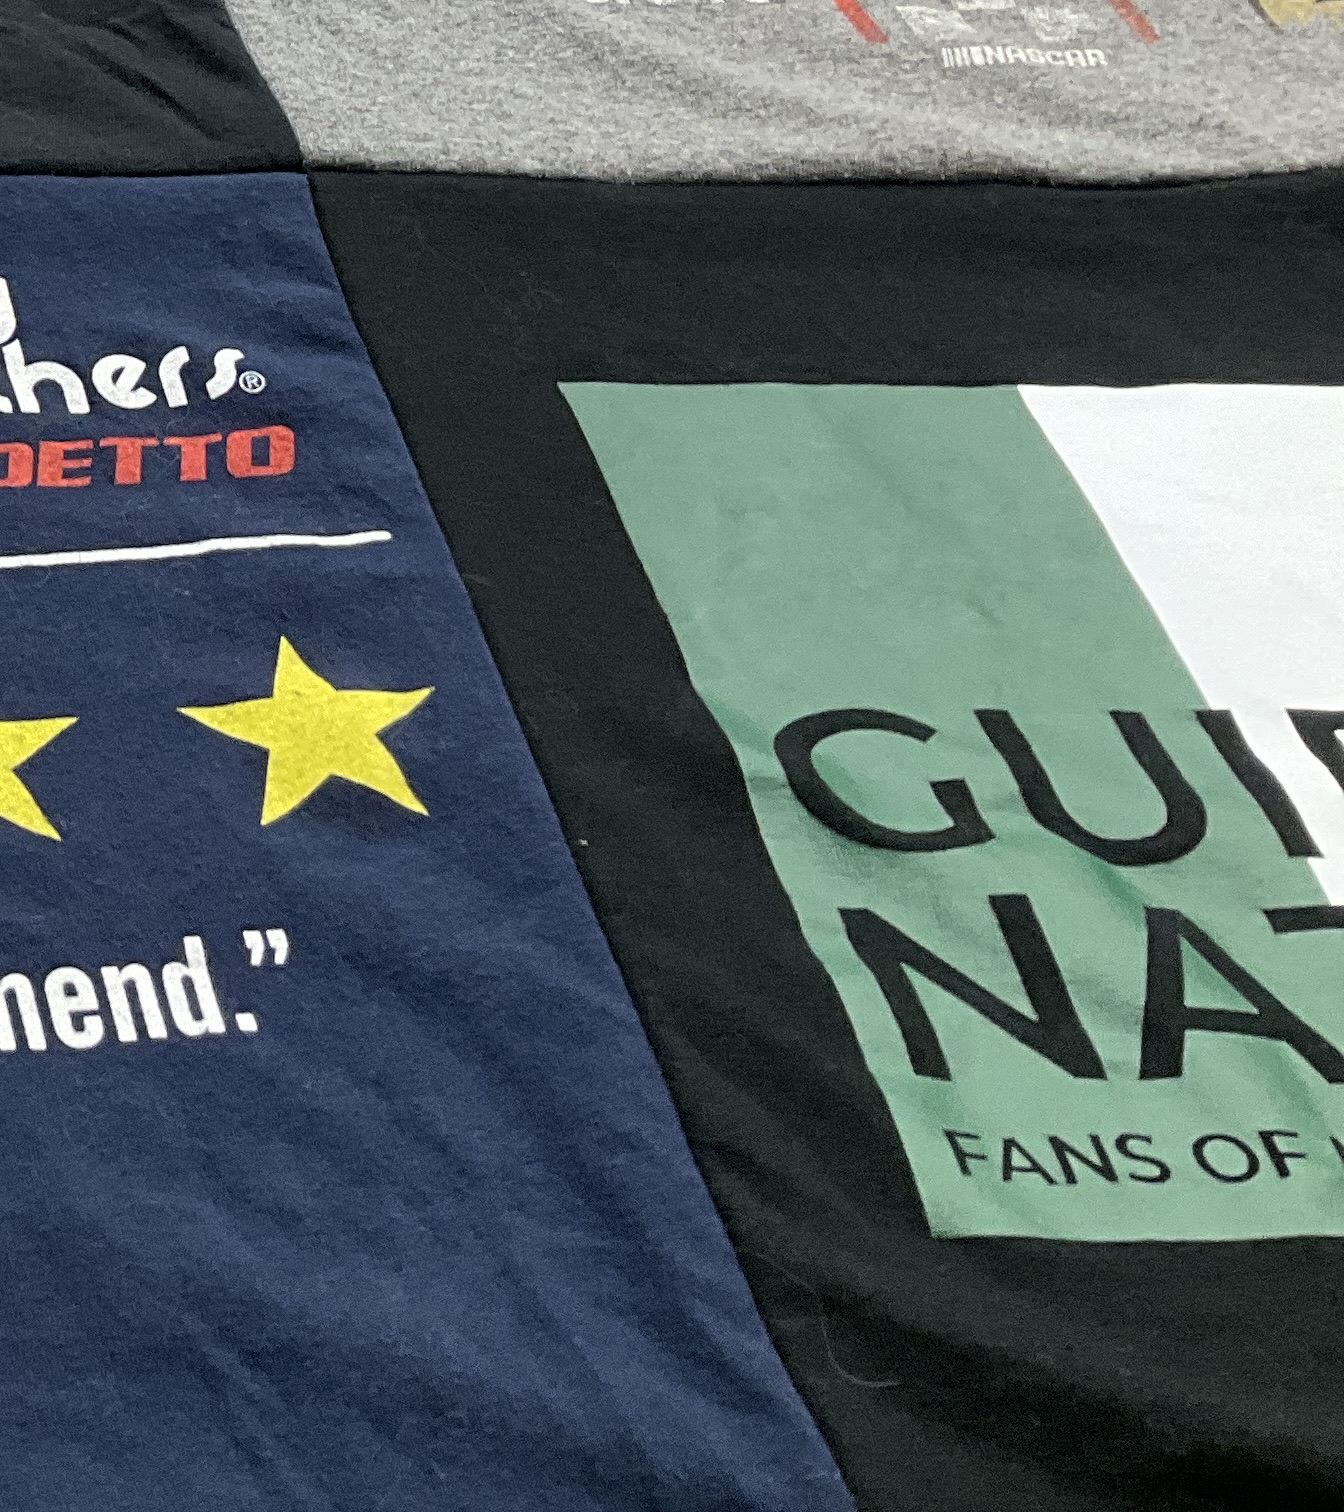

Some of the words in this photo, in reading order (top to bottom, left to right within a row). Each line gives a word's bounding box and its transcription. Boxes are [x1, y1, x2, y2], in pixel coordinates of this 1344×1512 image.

[944, 45, 1110, 72] NASCAR
[943, 1128, 1173, 1186] FANS
[1190, 1128, 1312, 1183] OF
